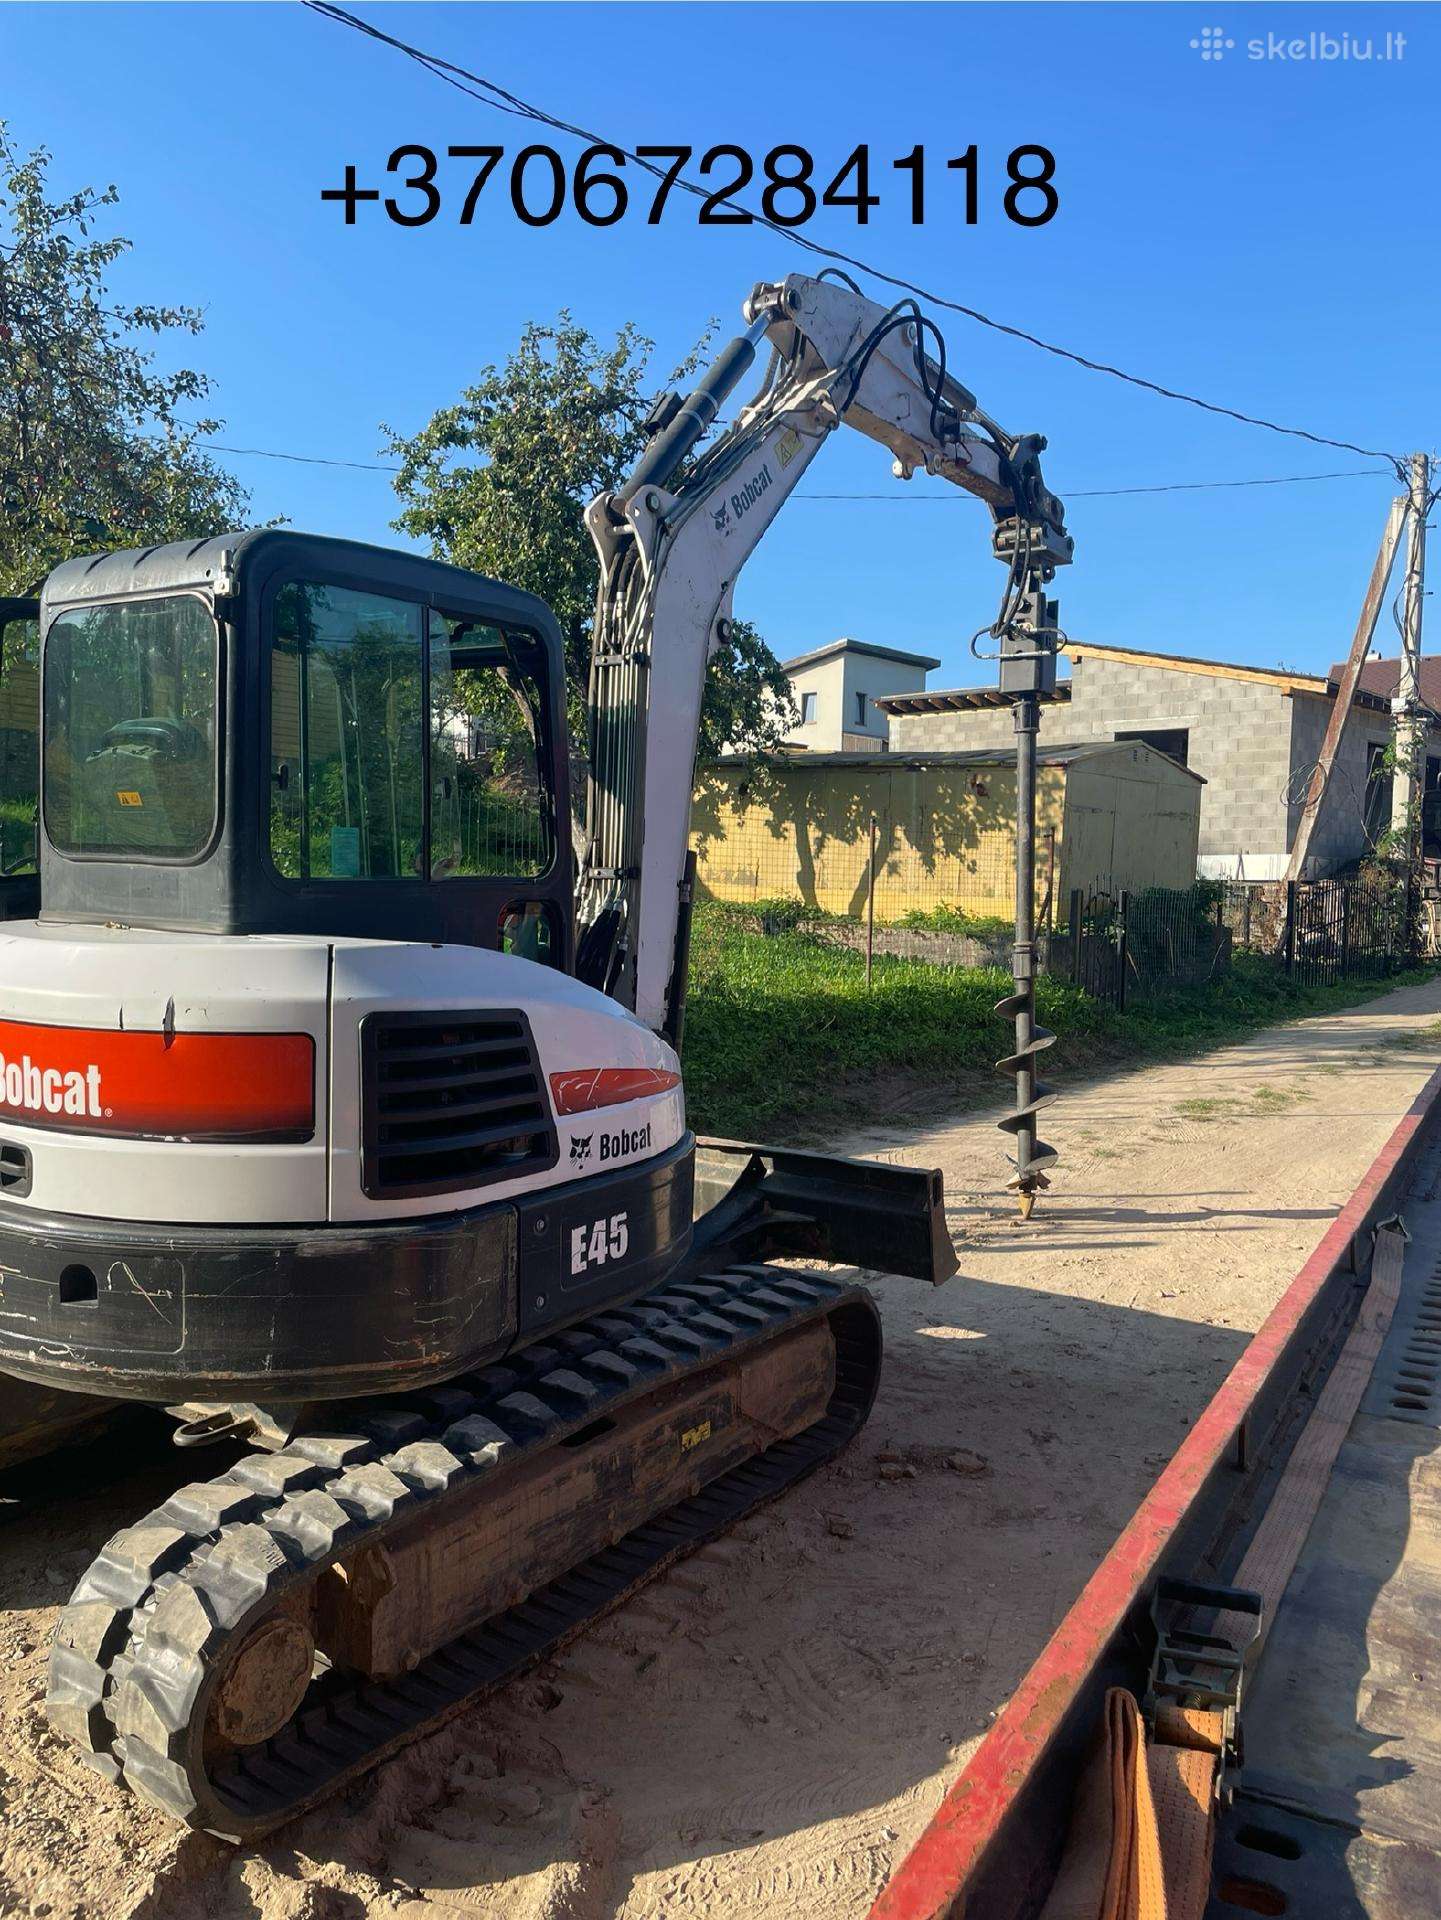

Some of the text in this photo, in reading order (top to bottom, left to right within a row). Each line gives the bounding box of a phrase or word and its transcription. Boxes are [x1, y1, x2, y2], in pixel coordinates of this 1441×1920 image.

[730, 463, 774, 520] Bobcat
[599, 1122, 651, 1162] Bobcat
[571, 1211, 629, 1275] E45
